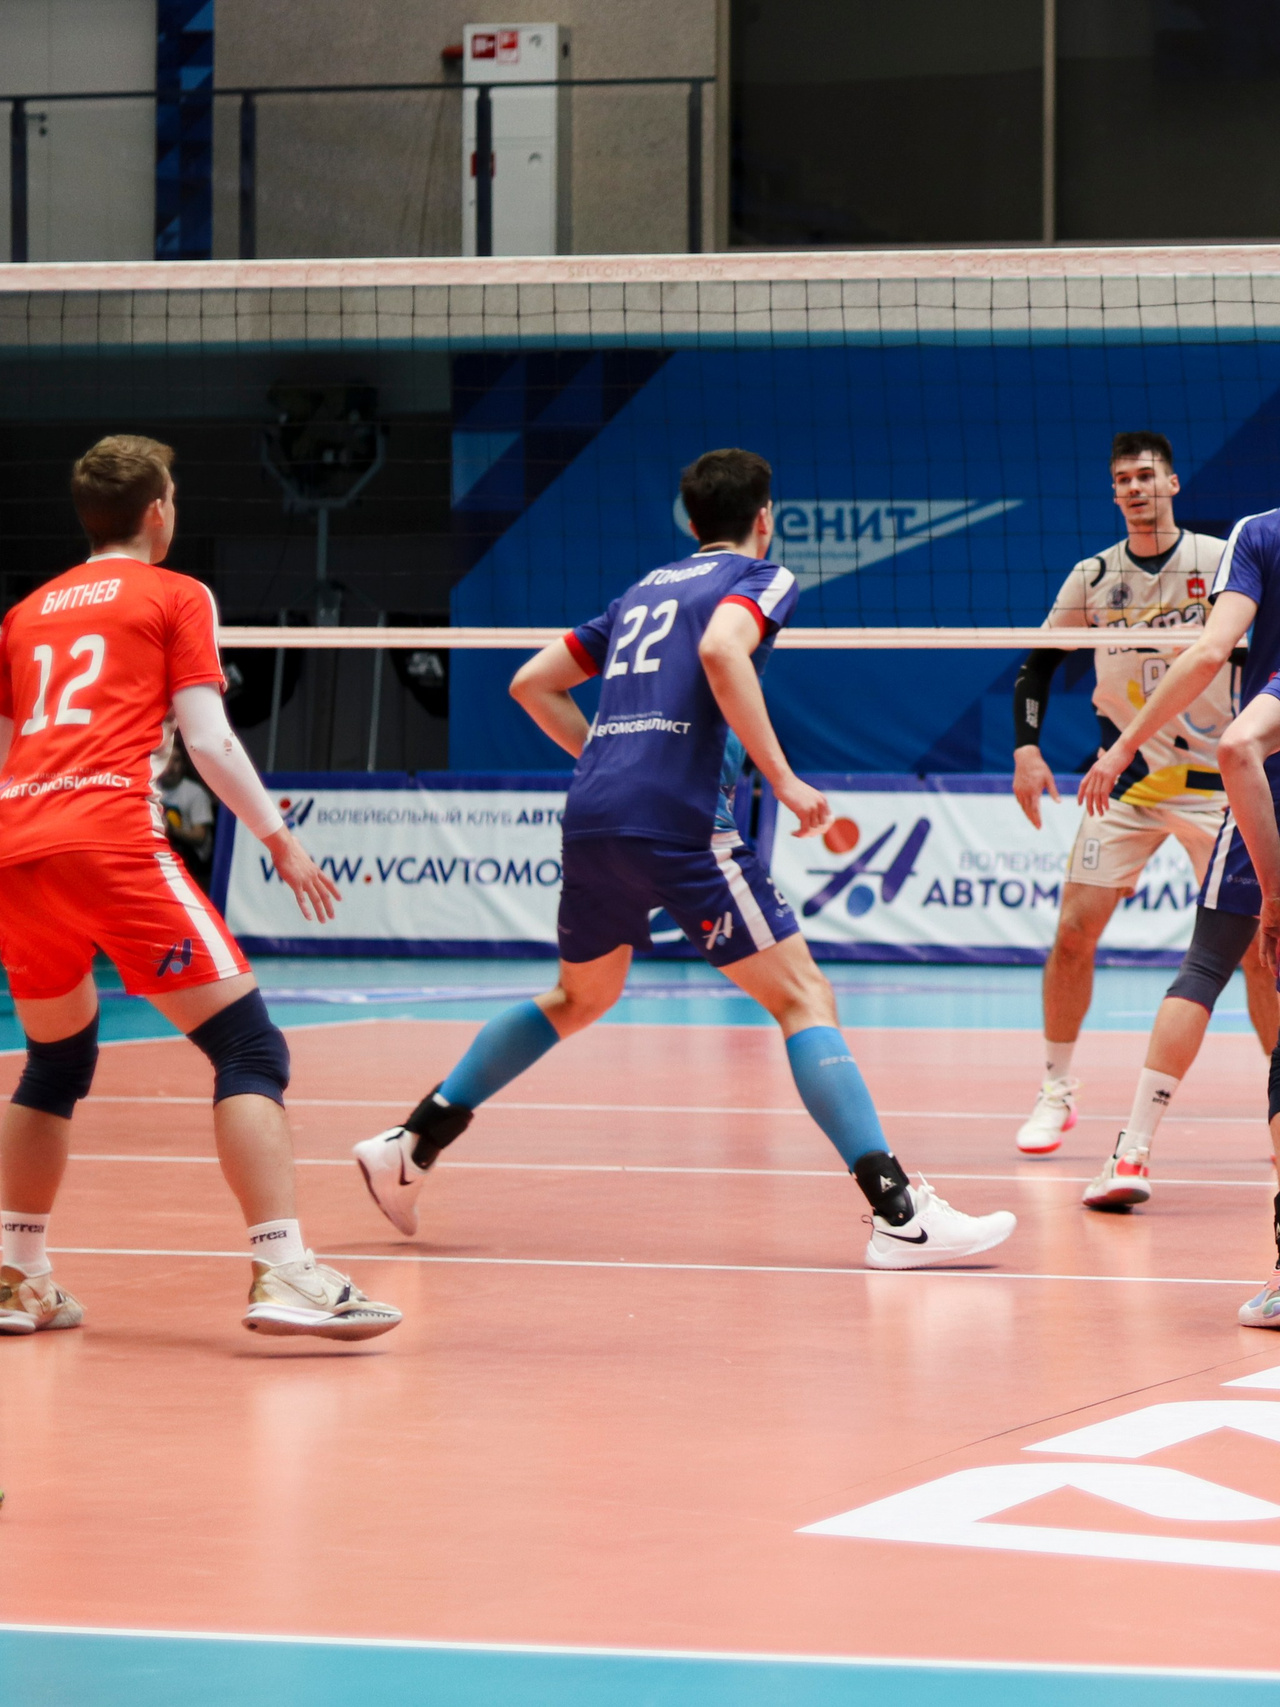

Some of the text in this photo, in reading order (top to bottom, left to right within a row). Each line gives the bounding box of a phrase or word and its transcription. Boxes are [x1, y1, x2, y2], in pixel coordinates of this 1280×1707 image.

[41, 578, 121, 615] БИТНЕВ
[605, 599, 678, 680] 22
[21, 634, 105, 736] 12
[1, 772, 131, 799] АВТОМОБИЛИСТ
[317, 806, 462, 826] ВОЛЕЙБОЛЬНЫЙ
[466, 808, 512, 825] КЛУБ
